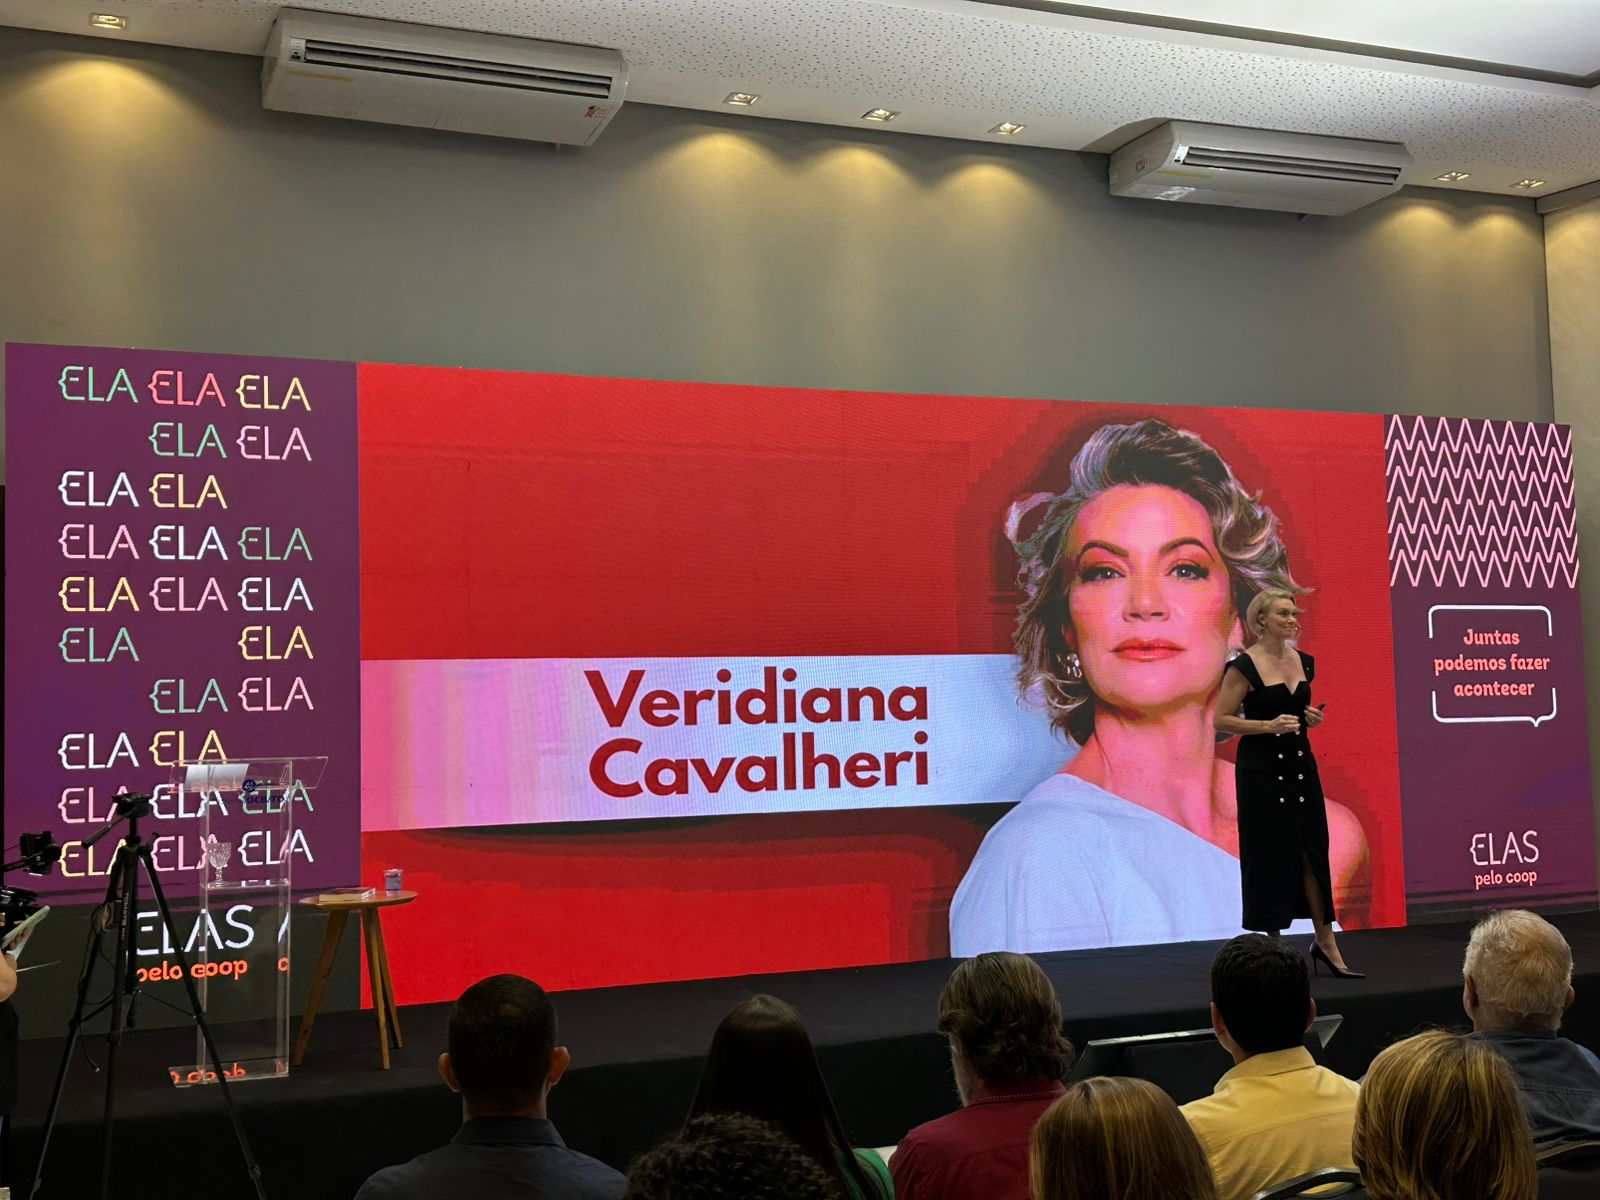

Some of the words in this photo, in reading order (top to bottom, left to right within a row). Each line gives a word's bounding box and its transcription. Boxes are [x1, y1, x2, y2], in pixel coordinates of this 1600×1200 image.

[58, 366, 138, 404] ELA
[148, 370, 226, 408] ELA
[236, 375, 312, 412] ELA
[148, 422, 227, 458] ELA
[236, 426, 312, 461] ELA
[58, 471, 140, 508] ELA
[149, 473, 228, 509] ELA
[58, 524, 140, 560] ELA
[149, 525, 228, 560] ELA
[238, 527, 313, 561] ELA
[58, 577, 140, 612] ELA
[149, 577, 228, 612] ELA
[238, 577, 314, 612] ELA
[58, 627, 140, 662] ELA
[238, 626, 314, 661] ELA
[1463, 629, 1520, 646] Juntas
[1434, 653, 1507, 677] podemos
[1510, 653, 1550, 671] fazer
[149, 679, 228, 713] ELA
[238, 677, 314, 712] ELA
[583, 666, 928, 728] Veridiana
[1453, 681, 1535, 697] acontecer
[58, 732, 140, 769] ELA
[149, 729, 228, 767] ELA
[589, 731, 929, 799] Cavalheri
[1469, 830, 1539, 866] ELAS
[1474, 870, 1503, 890] pelo
[1505, 871, 1538, 886] coop
[191, 959, 248, 981] coop
